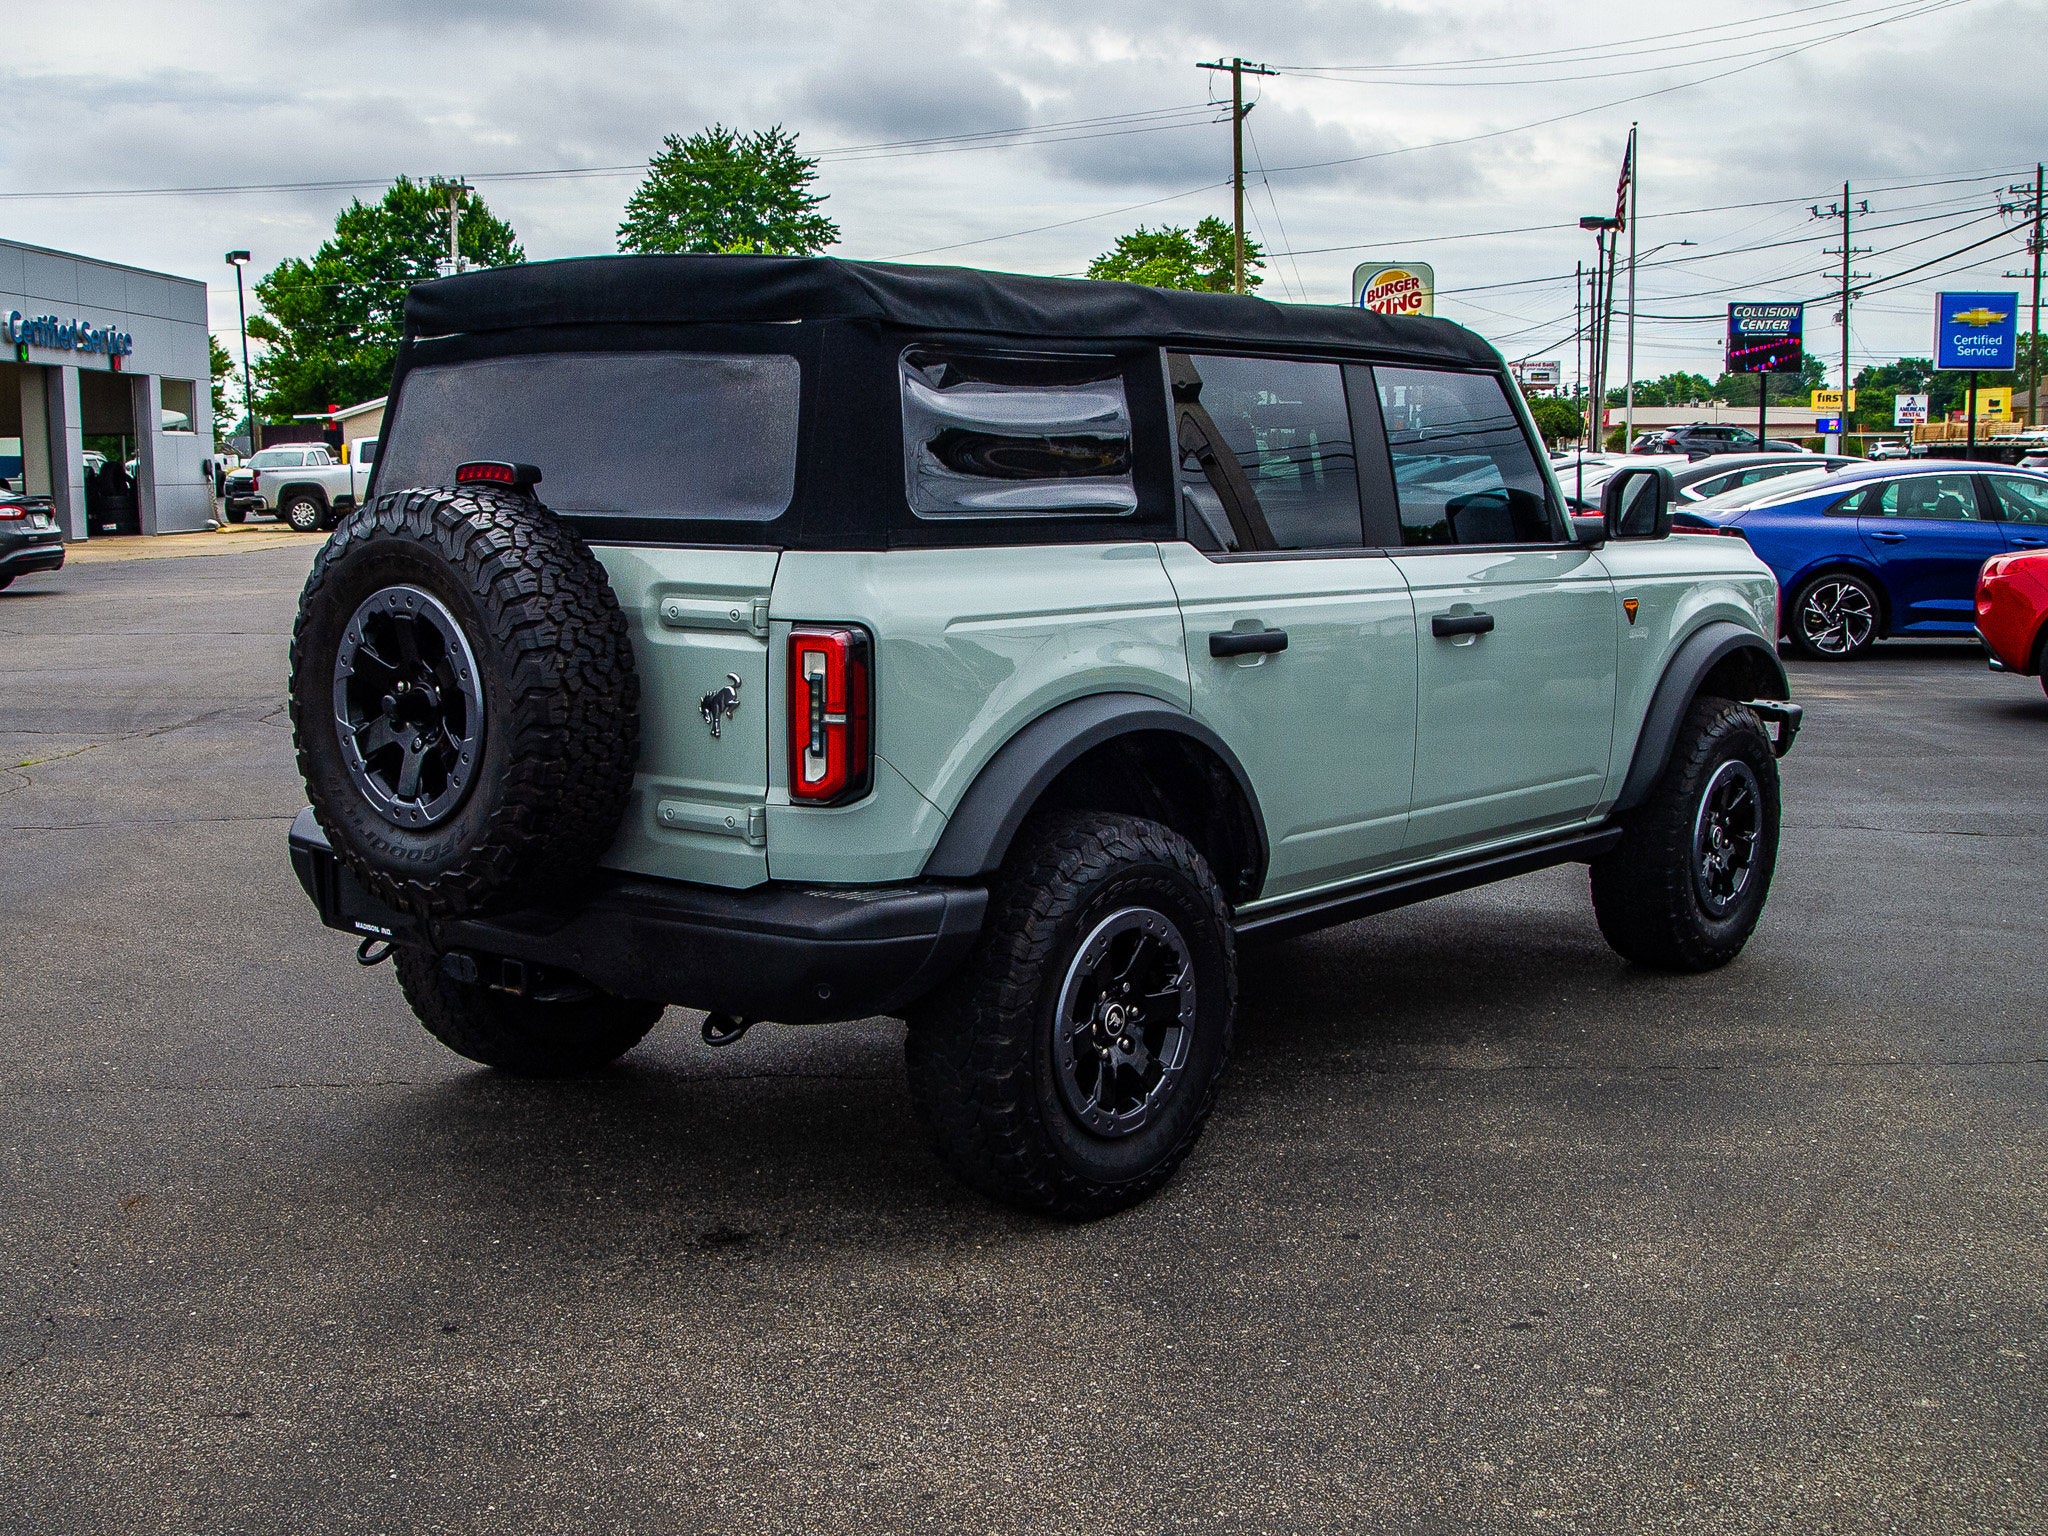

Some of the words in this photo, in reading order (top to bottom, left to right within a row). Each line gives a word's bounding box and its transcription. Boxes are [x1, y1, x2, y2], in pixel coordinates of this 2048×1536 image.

[1366, 277, 1420, 304] BURGER
[1733, 305, 1799, 318] COLLISION
[1739, 318, 1790, 331] CENTER
[8, 310, 78, 350] Certified
[79, 321, 133, 355] Service
[1953, 334, 2003, 345] Certified
[1957, 345, 1999, 356] Service
